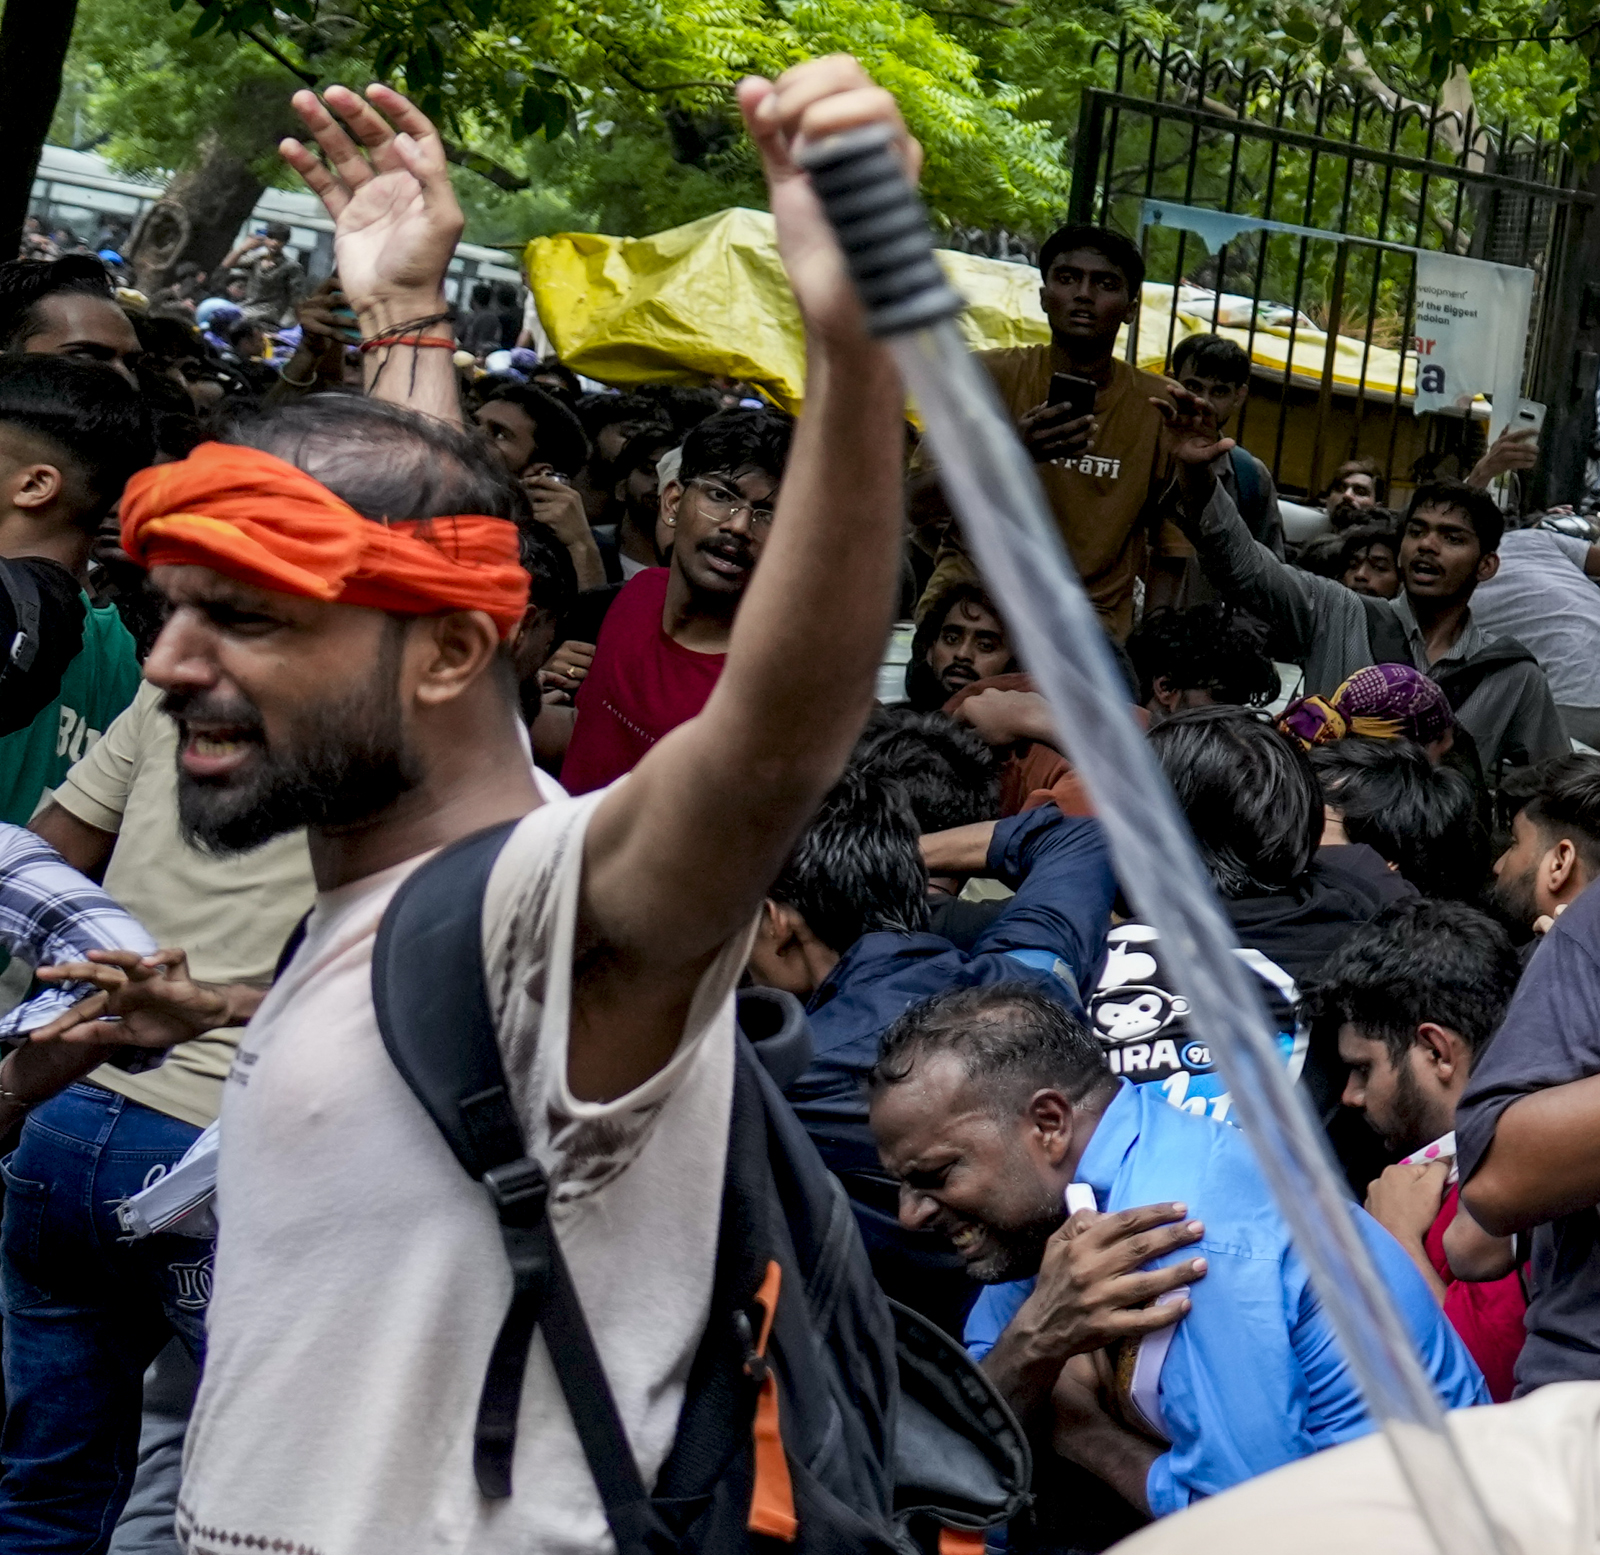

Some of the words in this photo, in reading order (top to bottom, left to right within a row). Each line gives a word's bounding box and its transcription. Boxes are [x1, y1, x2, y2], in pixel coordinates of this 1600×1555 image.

[1427, 302, 1442, 312] the
[1444, 304, 1478, 318] Biggest
[1417, 313, 1450, 325] ndolan
[1105, 1039, 1182, 1075] IRA
